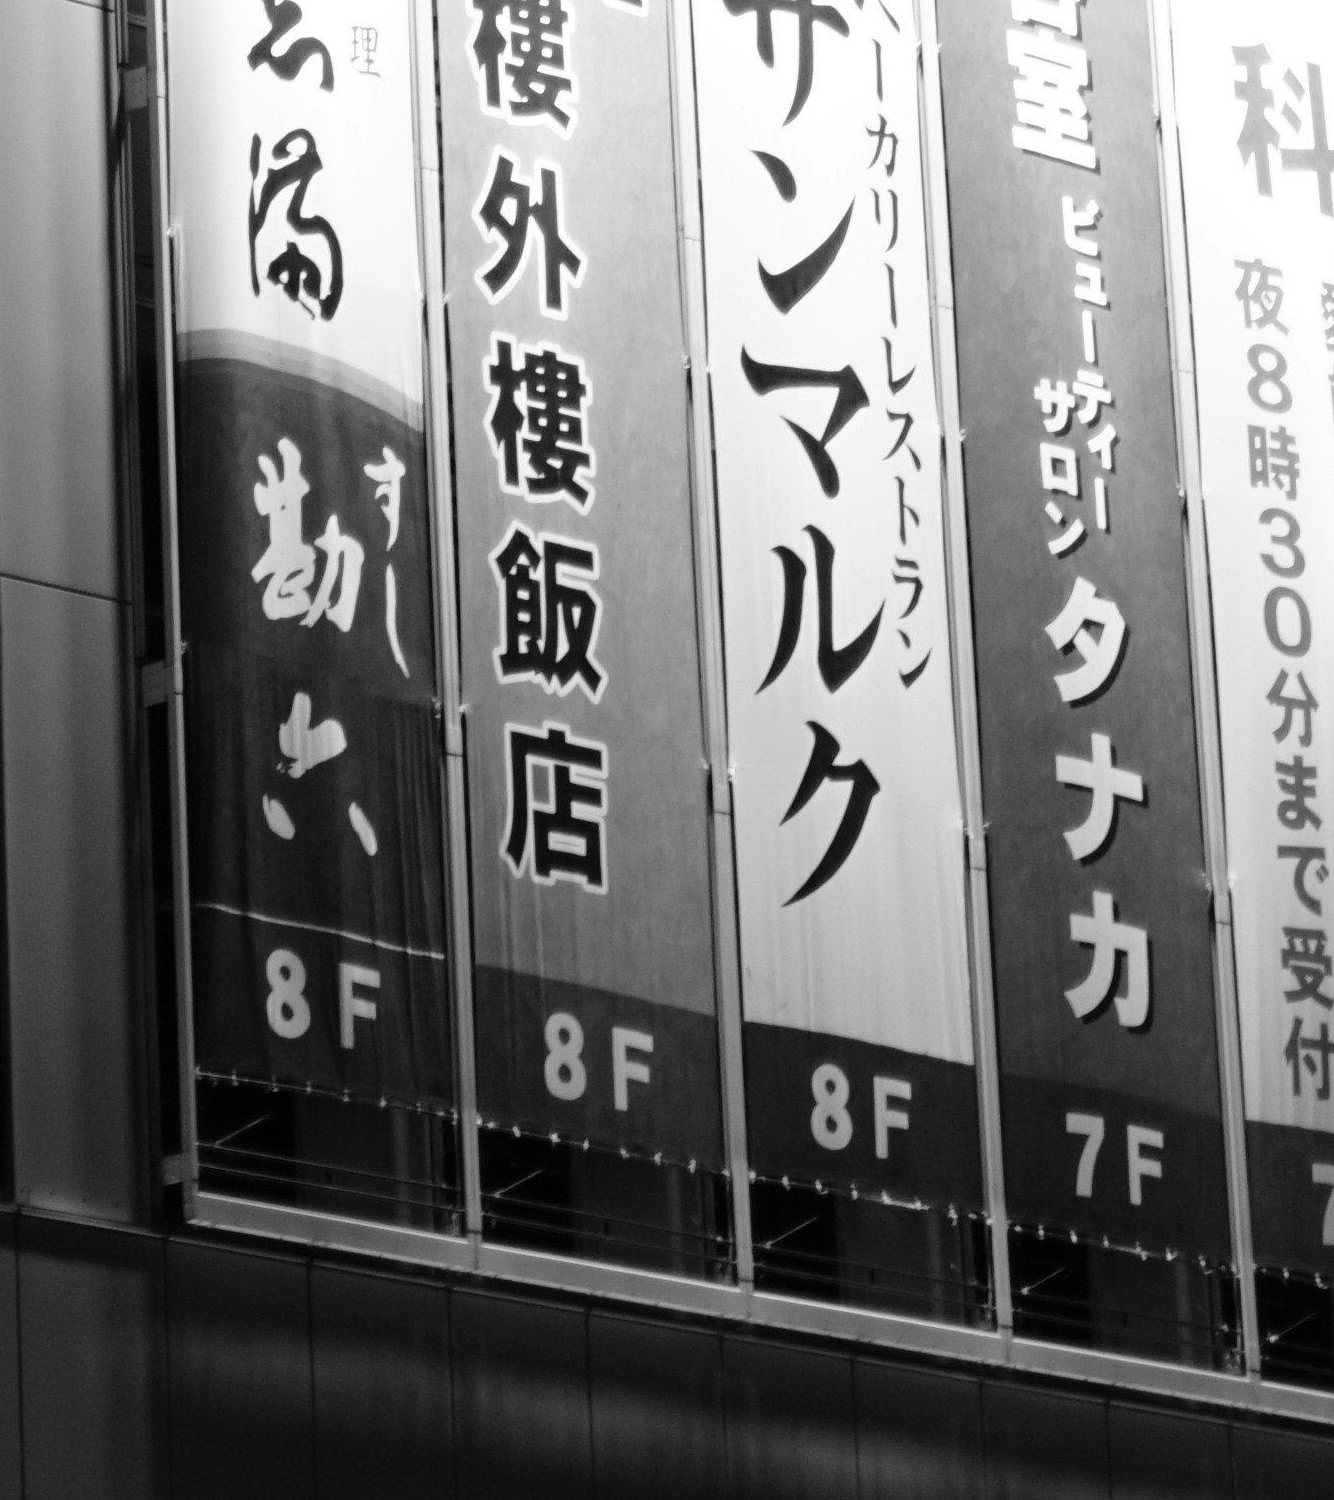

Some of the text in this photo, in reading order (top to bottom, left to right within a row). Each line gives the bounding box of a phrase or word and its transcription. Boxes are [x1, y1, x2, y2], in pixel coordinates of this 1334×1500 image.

[363, 445, 410, 679] すし
[1033, 377, 1085, 556] サロン
[1044, 576, 1150, 1029] タナカ
